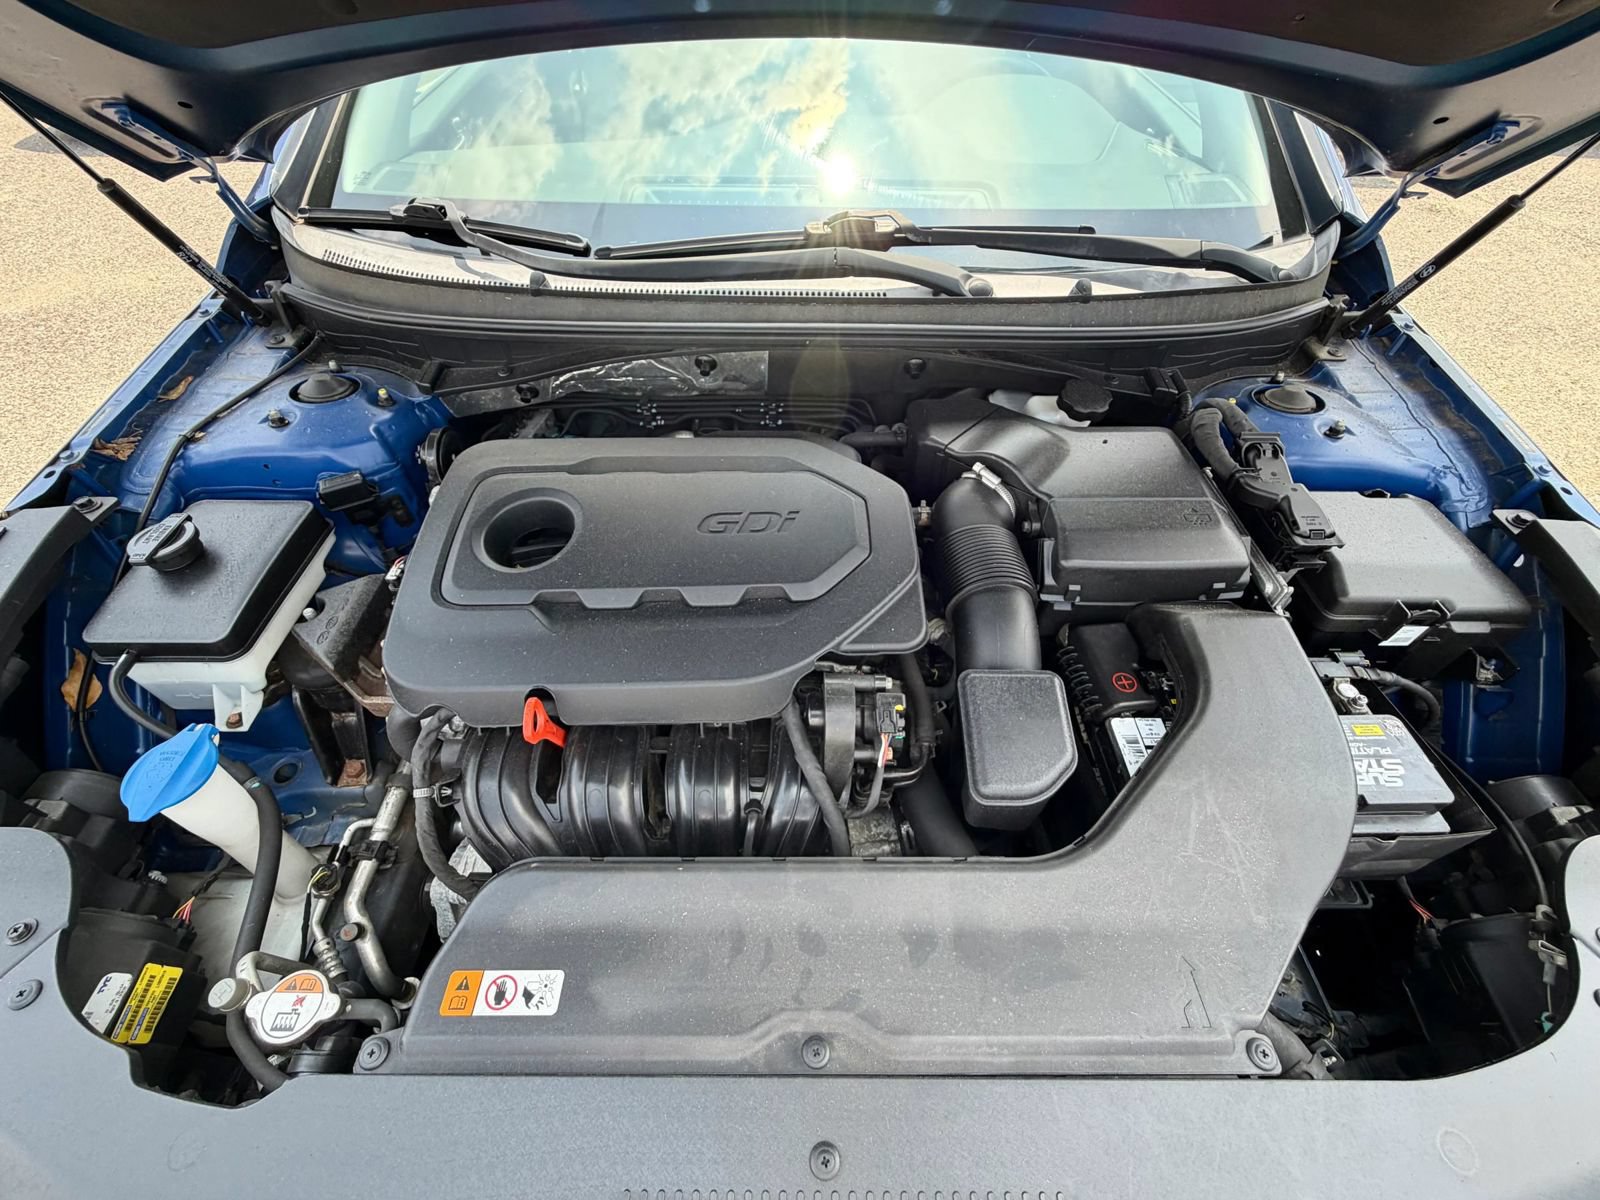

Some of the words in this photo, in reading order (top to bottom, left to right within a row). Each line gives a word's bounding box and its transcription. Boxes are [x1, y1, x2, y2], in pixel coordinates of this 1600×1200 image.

[176, 251, 193, 263] RH
[695, 509, 801, 535] GDi
[97, 976, 113, 995] TYC
